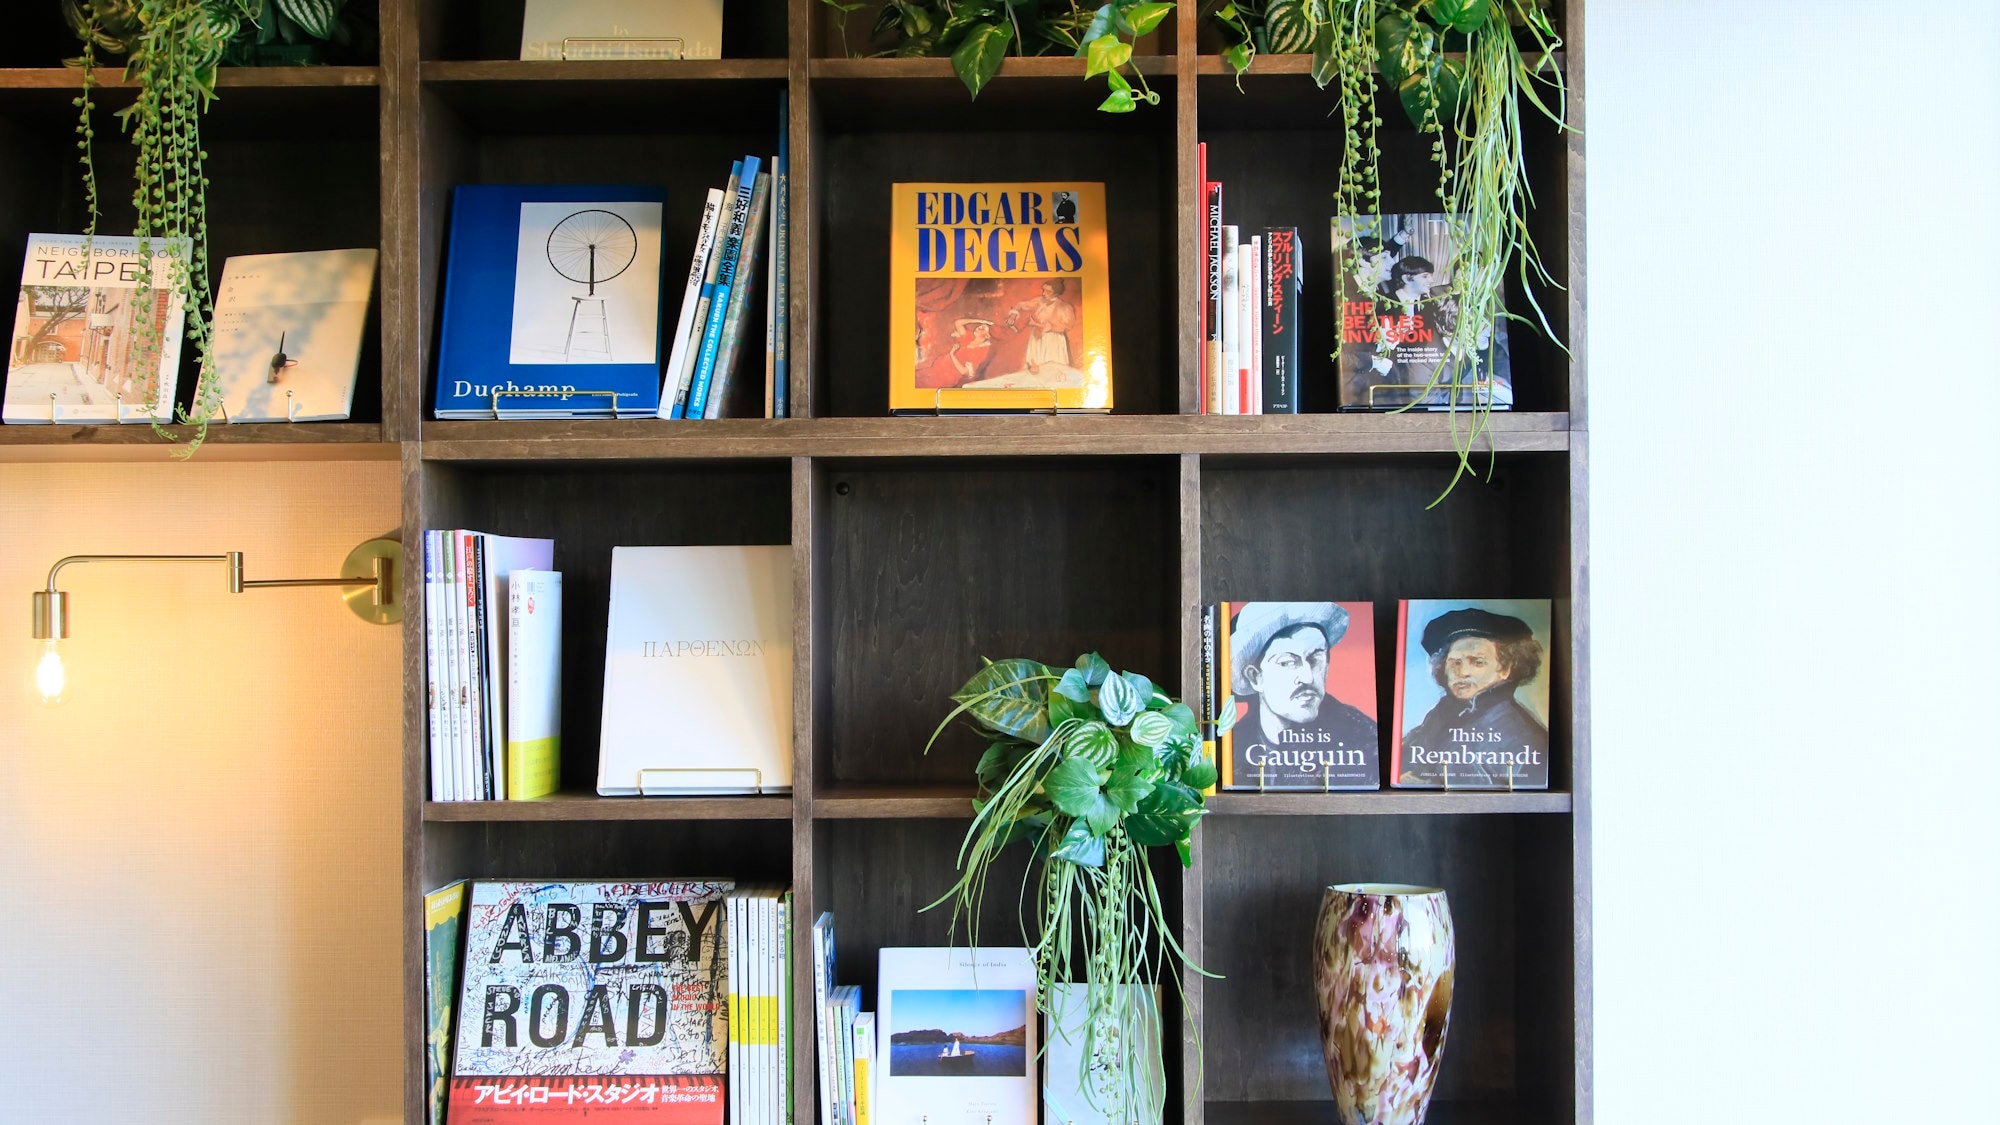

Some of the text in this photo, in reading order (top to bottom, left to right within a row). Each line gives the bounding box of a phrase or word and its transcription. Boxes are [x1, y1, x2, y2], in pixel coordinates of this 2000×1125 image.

[915, 192, 1048, 225] EDGAR
[915, 226, 1083, 273] DEGAS
[1208, 205, 1219, 300] MICHAEL JACKSON
[1283, 231, 1294, 279] ブルース・
[36, 259, 149, 282] TAIPE
[1272, 232, 1283, 335] スプリングスティーン
[713, 292, 725, 323] RAKUEN
[1339, 301, 1374, 316] THE
[709, 323, 718, 338] THE
[1341, 315, 1425, 329] BEATLES
[1340, 329, 1433, 343] INVASION
[700, 339, 714, 380] COLLECTED
[453, 380, 576, 401] Duchamp
[693, 381, 704, 408] WORKS
[642, 639, 767, 658] ΠΑΡΘΕΝΩΝ
[1278, 728, 1331, 743] This is
[1449, 728, 1502, 742] This is
[1245, 742, 1367, 773] Gauguin
[1409, 745, 1541, 765] Rembrandt
[489, 901, 719, 963] ABBEY
[481, 984, 668, 1049] ROAD
[695, 1003, 720, 1011] WORLD
[474, 1084, 660, 1105] アビイ・ロード・スタジオ
